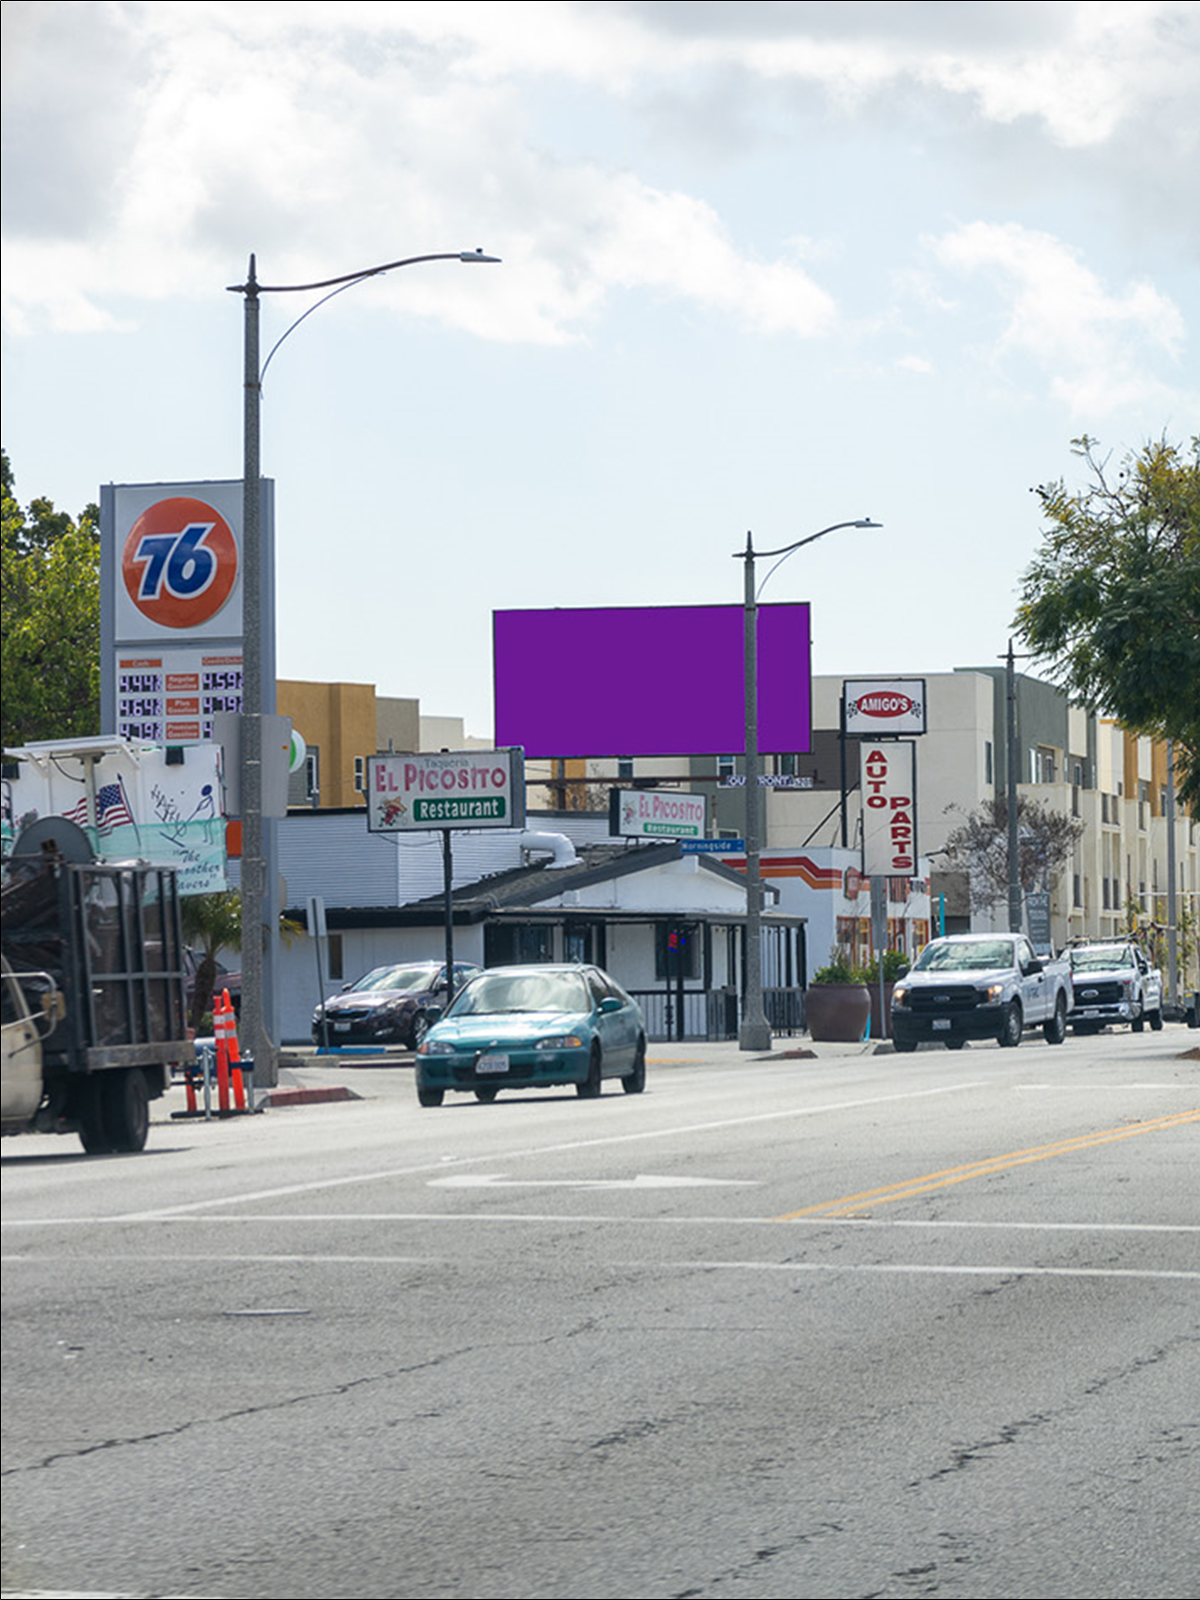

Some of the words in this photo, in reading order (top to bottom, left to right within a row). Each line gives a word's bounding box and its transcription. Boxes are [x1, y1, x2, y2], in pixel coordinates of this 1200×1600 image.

[133, 523, 216, 601] 76
[860, 698, 909, 711] AMIGO'S
[728, 775, 790, 787] OURONT
[865, 750, 888, 809] AUTO
[420, 799, 499, 818] Restaurant
[647, 824, 694, 835] Restaurant
[889, 796, 913, 869] PARTS
[682, 841, 732, 851] Morningside
[176, 863, 220, 876] moother
